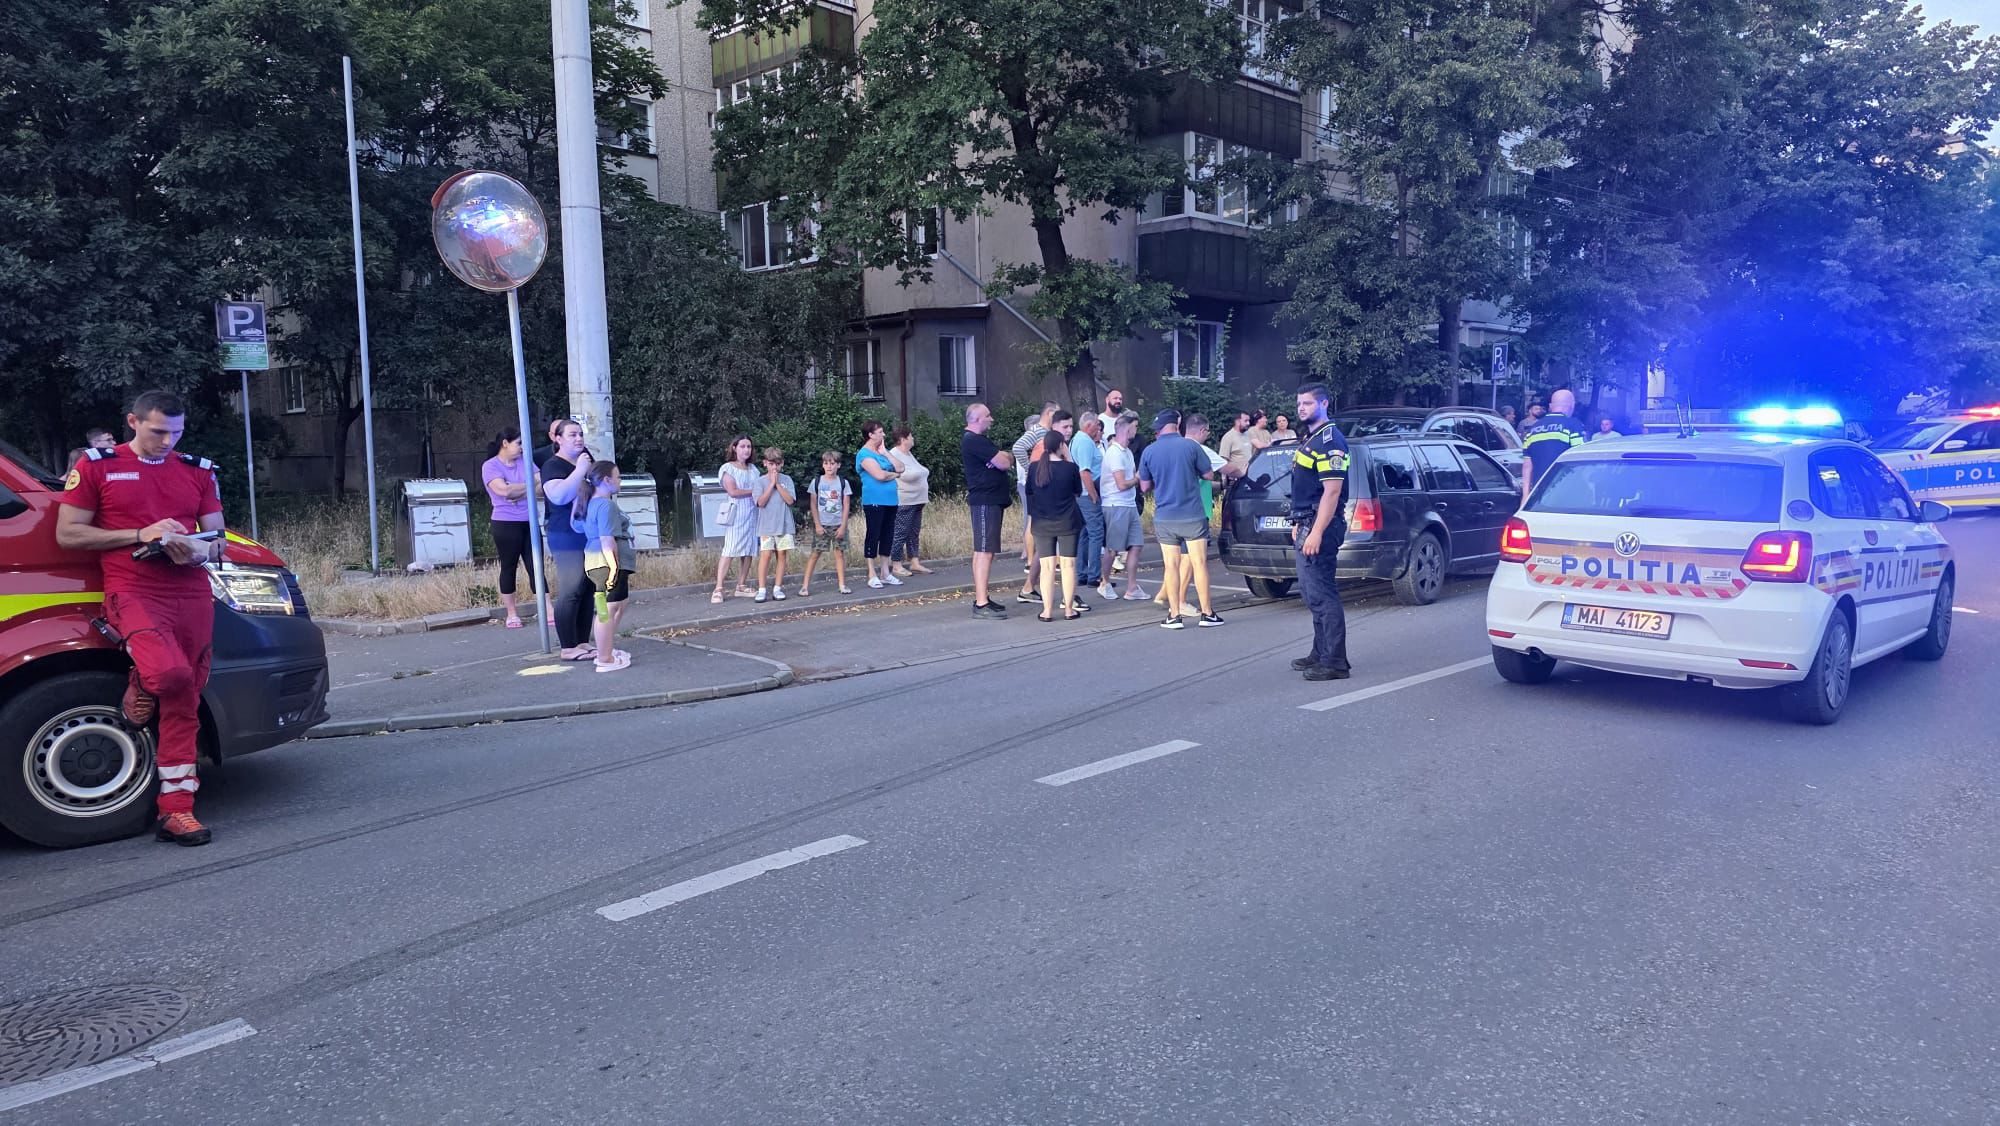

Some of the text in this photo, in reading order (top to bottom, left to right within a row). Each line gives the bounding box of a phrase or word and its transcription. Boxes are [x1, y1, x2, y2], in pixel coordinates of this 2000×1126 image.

[228, 306, 254, 336] P
[1494, 347, 1502, 364] P
[1530, 423, 1563, 435] POLITIA
[1955, 467, 1996, 481] POL
[1265, 517, 1279, 527] BH
[1561, 554, 1701, 585] POLITIA
[1863, 558, 1920, 592] POLITIA
[1577, 607, 1605, 625] MAI
[1615, 611, 1663, 631] 41173
